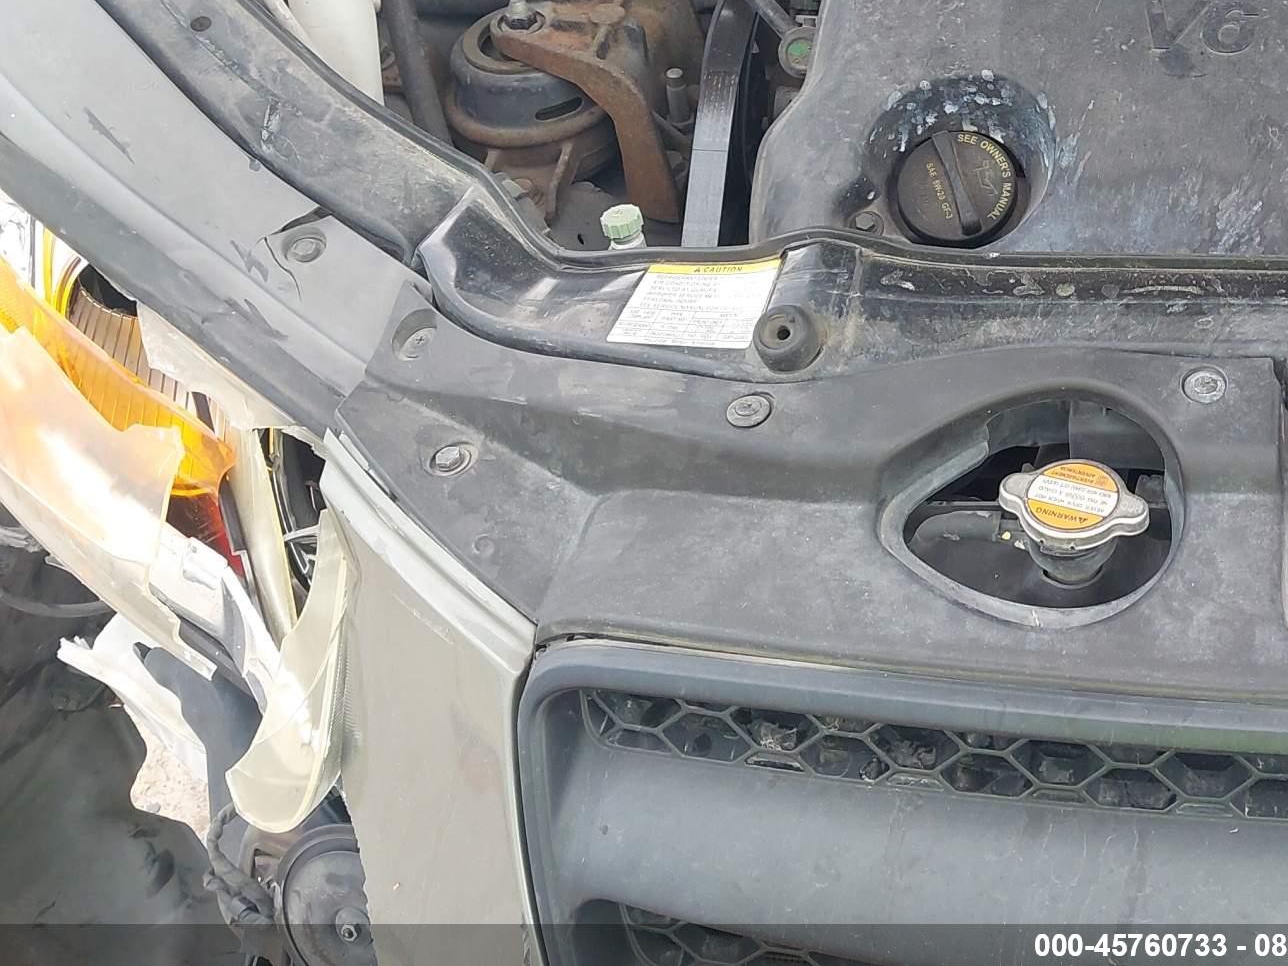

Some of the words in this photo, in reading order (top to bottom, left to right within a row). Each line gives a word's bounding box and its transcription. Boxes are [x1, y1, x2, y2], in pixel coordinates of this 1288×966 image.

[1144, 0, 1260, 55] V6
[956, 133, 977, 145] SEE
[979, 140, 1012, 179] OWNER'S
[986, 182, 1012, 221] MANUAL
[702, 266, 744, 274] CAUTION
[1035, 506, 1078, 522] WARNING
